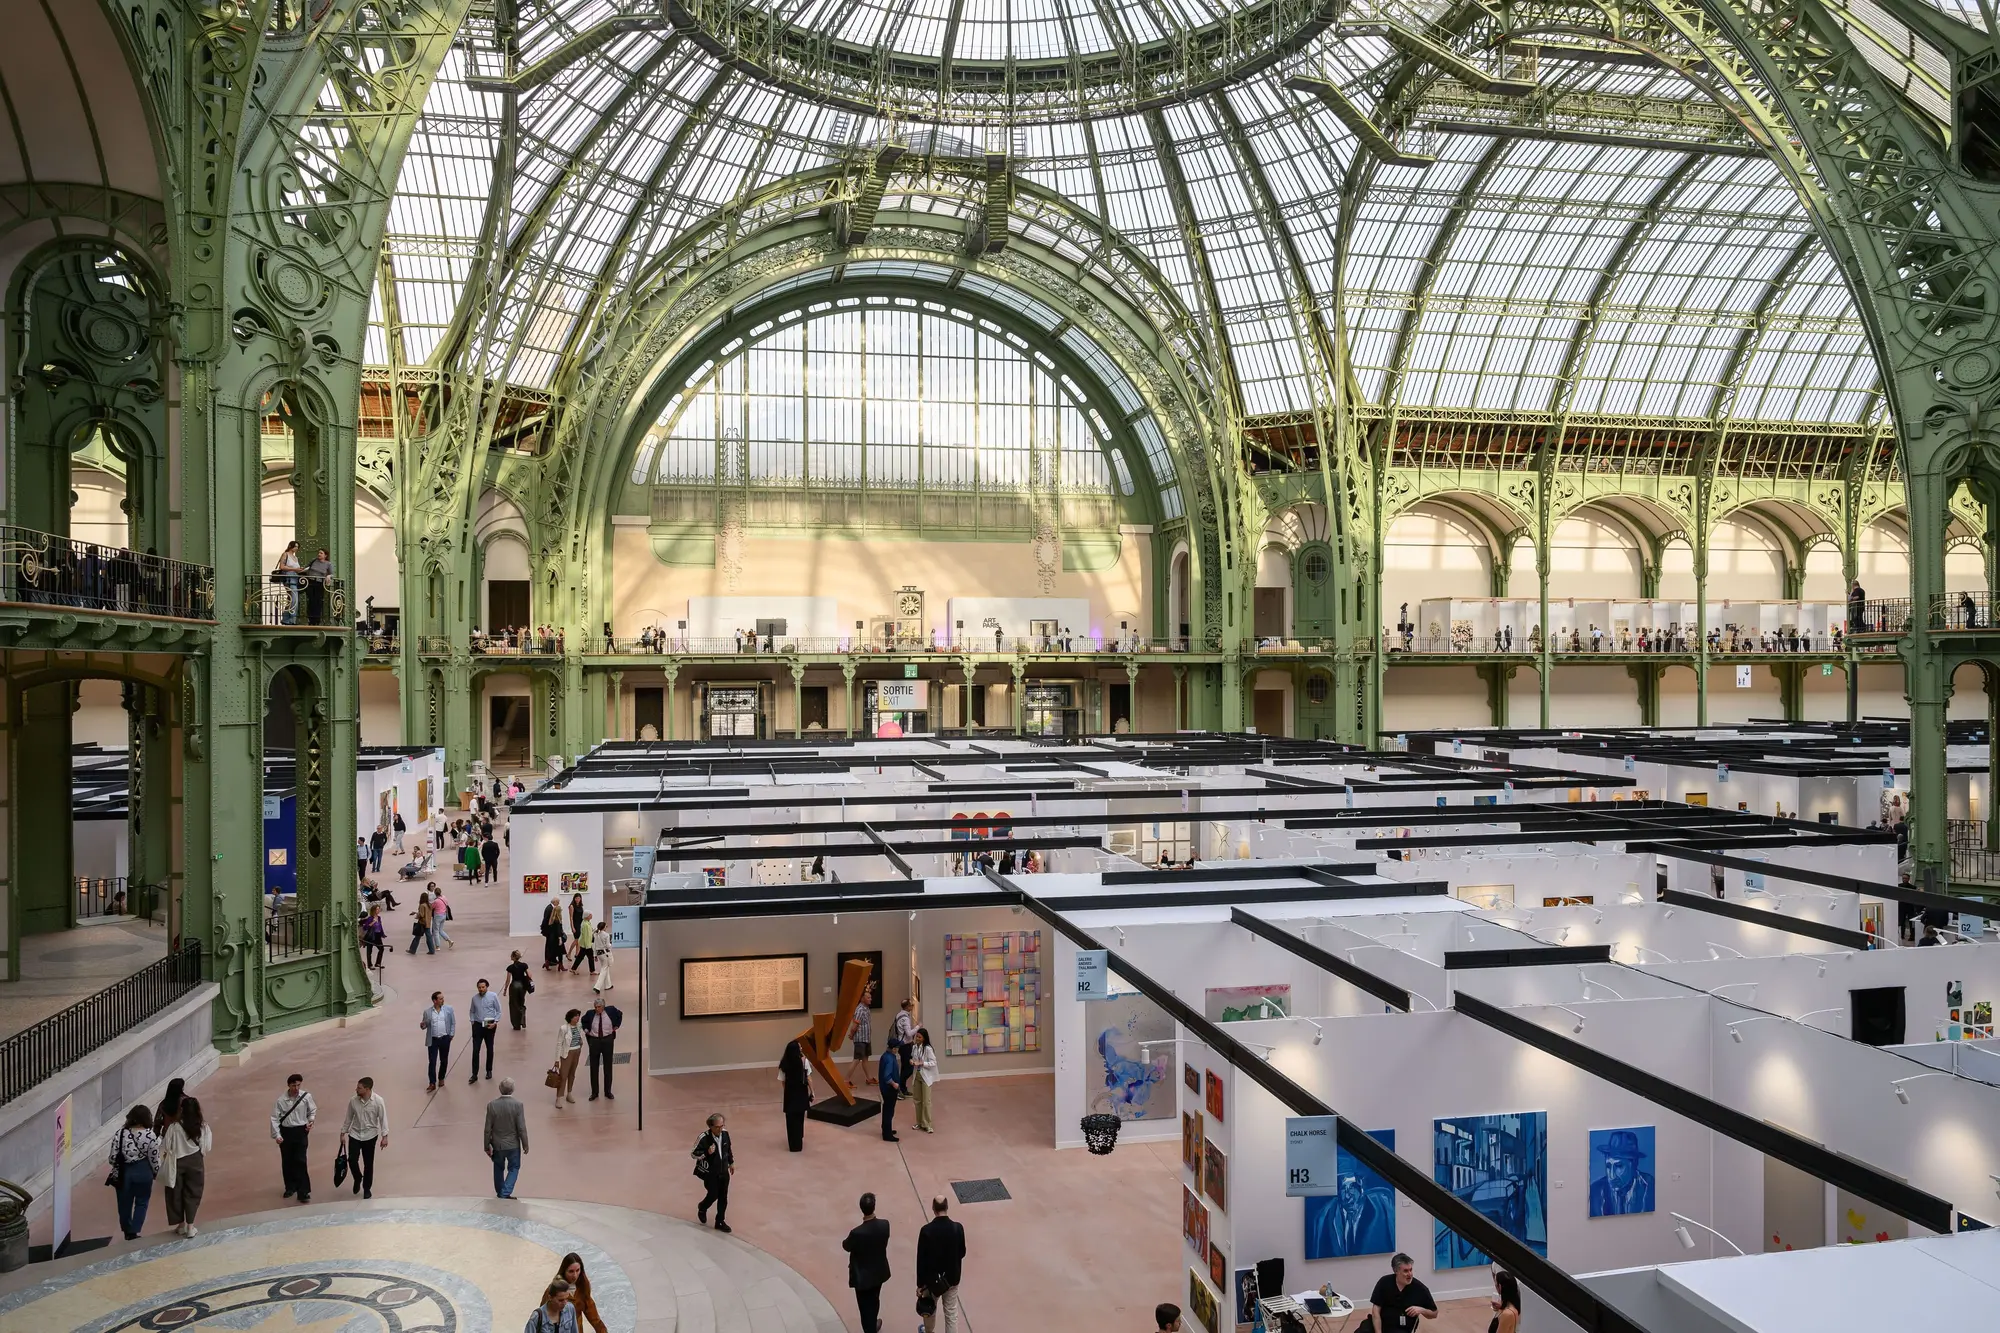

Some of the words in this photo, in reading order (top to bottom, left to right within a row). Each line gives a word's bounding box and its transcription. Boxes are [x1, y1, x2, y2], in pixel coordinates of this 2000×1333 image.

[883, 686, 914, 695] SORTIE
[884, 696, 900, 706] EXIT
[614, 932, 624, 940] H1
[1078, 982, 1090, 991] H2
[1290, 1168, 1309, 1183] H3
